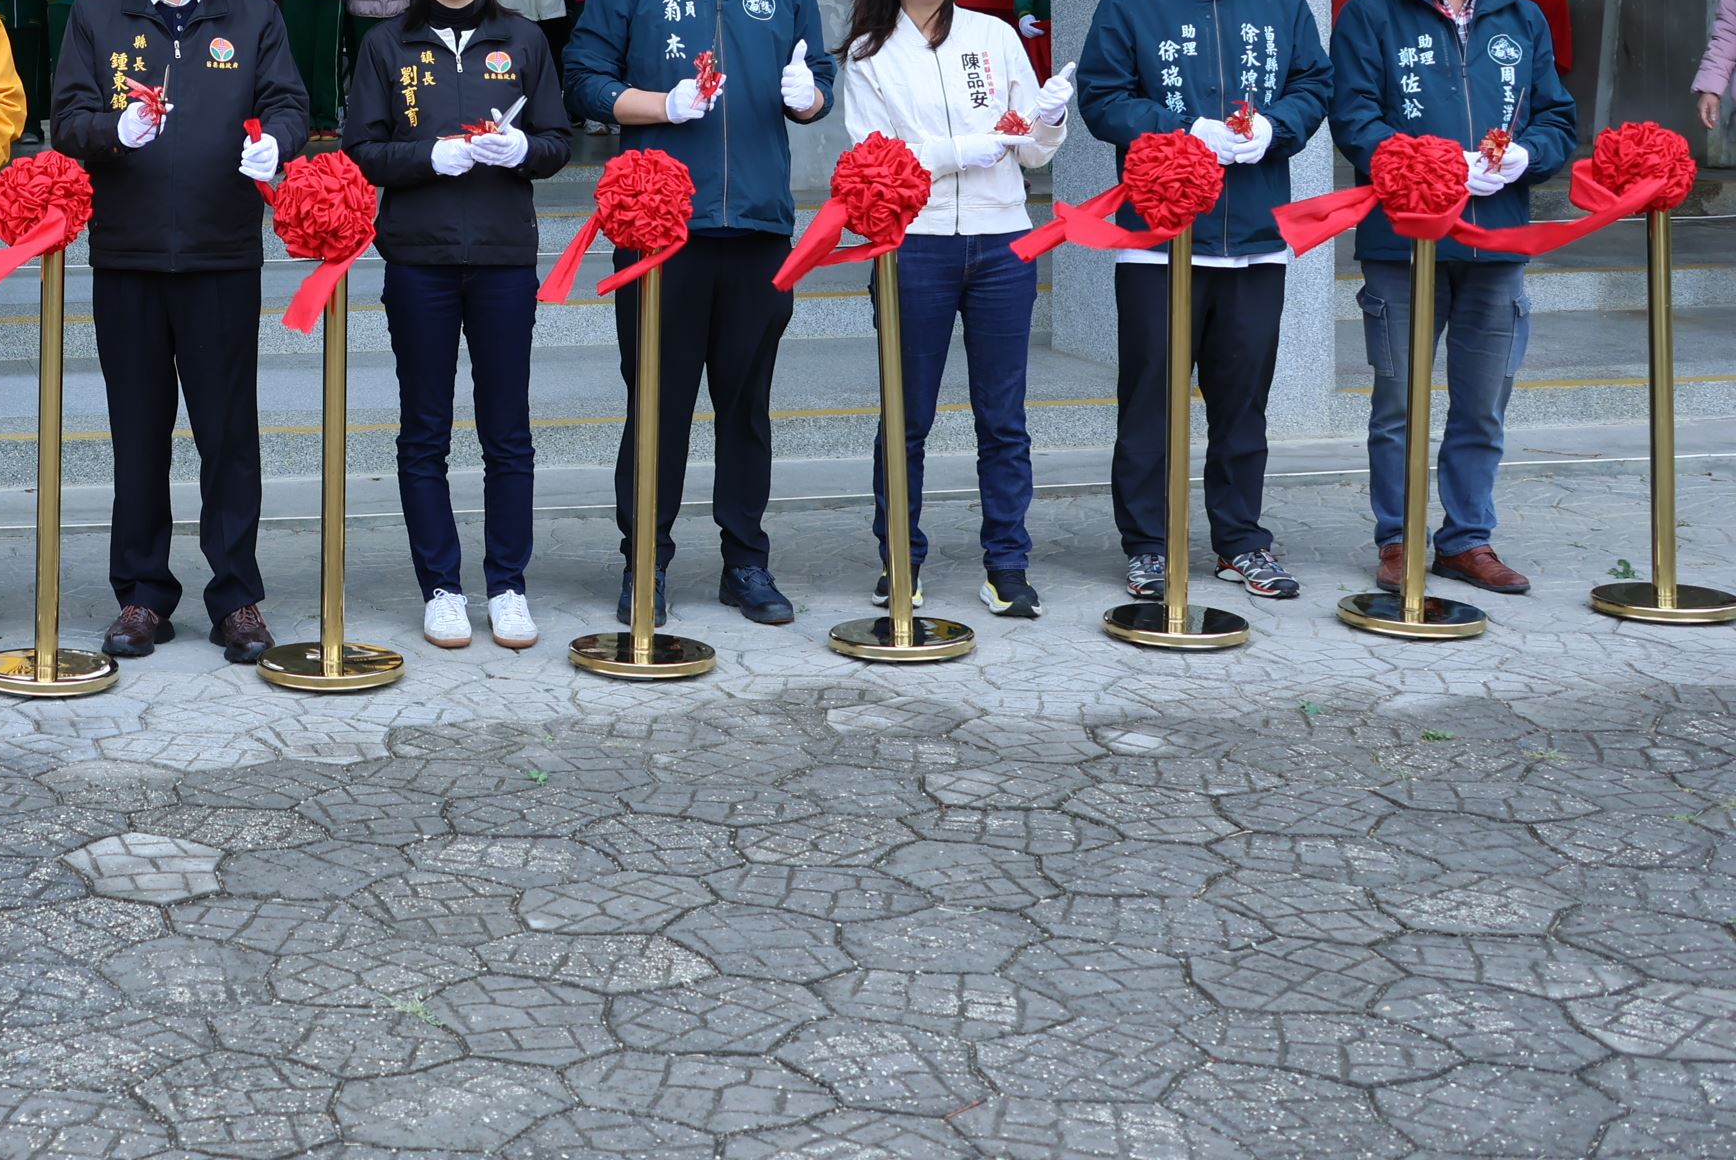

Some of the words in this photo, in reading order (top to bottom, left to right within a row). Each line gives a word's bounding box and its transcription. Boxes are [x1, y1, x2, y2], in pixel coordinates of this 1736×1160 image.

[132, 34, 148, 72] 縣長
[420, 50, 437, 87] 鎮長
[1181, 23, 1198, 57] 助理
[1240, 22, 1262, 102] 徐永煌
[1263, 25, 1279, 107] 苗栗縣議員
[1417, 33, 1436, 67] 助理
[109, 51, 130, 111] 鍾東錦
[961, 51, 990, 109] 陳品安
[1397, 46, 1425, 121] 鄭佐松
